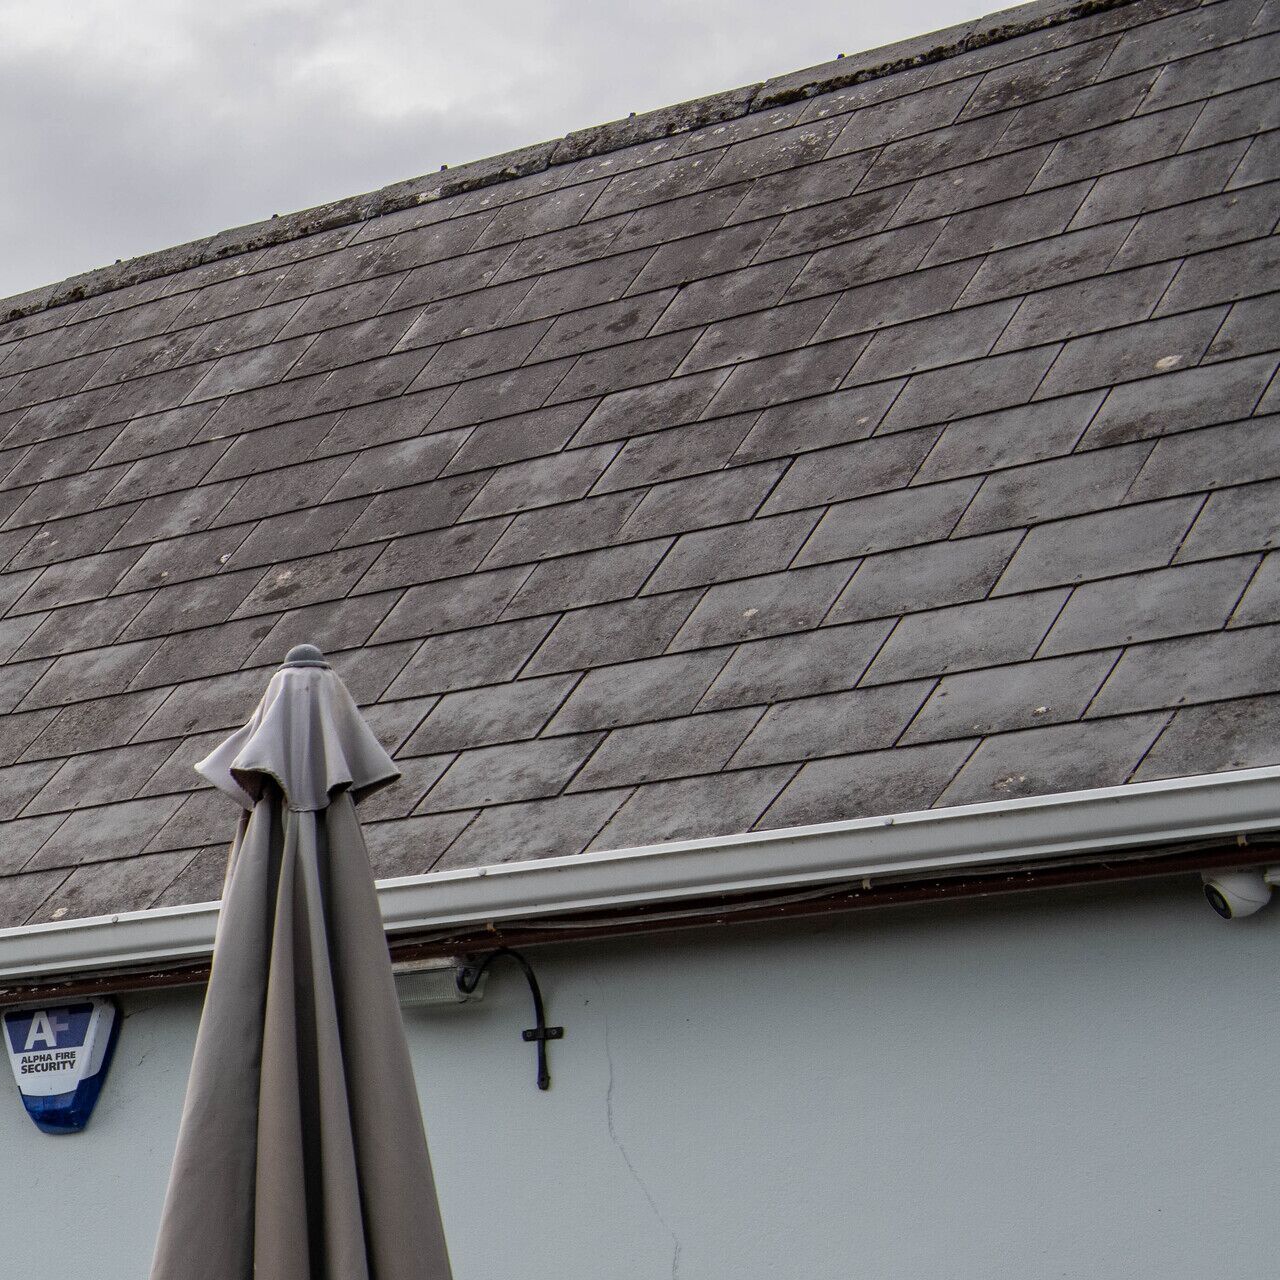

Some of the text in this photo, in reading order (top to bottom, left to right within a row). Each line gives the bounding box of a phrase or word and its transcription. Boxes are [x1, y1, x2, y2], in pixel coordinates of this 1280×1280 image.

[21, 1051, 76, 1064] ALPHA FIRE
[21, 1060, 76, 1075] SECURITY
